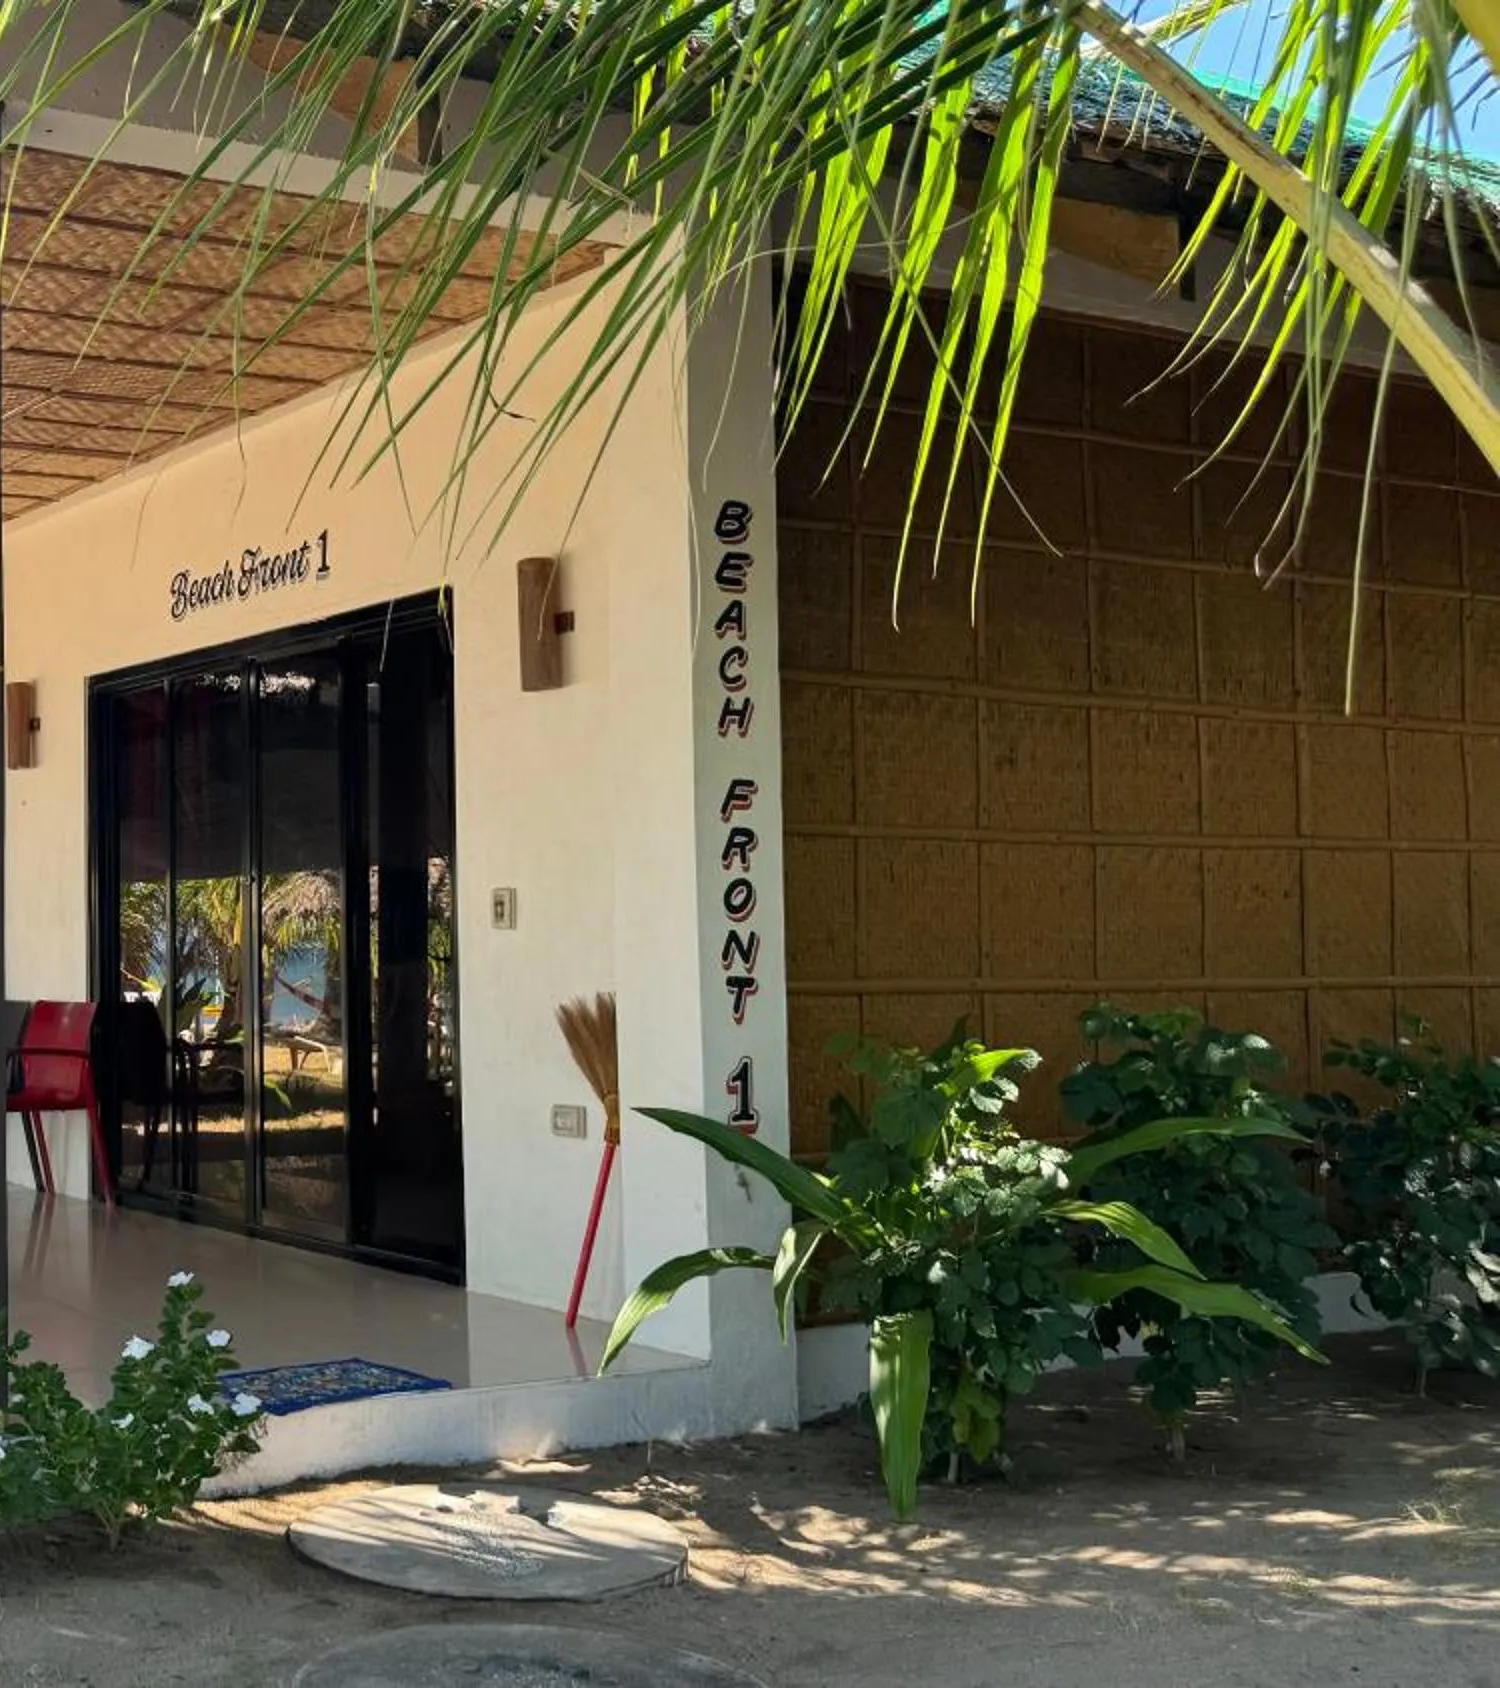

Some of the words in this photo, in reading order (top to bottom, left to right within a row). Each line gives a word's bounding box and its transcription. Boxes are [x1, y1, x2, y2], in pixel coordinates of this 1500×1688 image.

[169, 559, 234, 621] Beach
[237, 541, 311, 599] Front
[316, 528, 331, 576] 1
[713, 499, 754, 738] BEACH
[720, 778, 759, 1024] FRONT
[726, 1055, 759, 1134] 1
